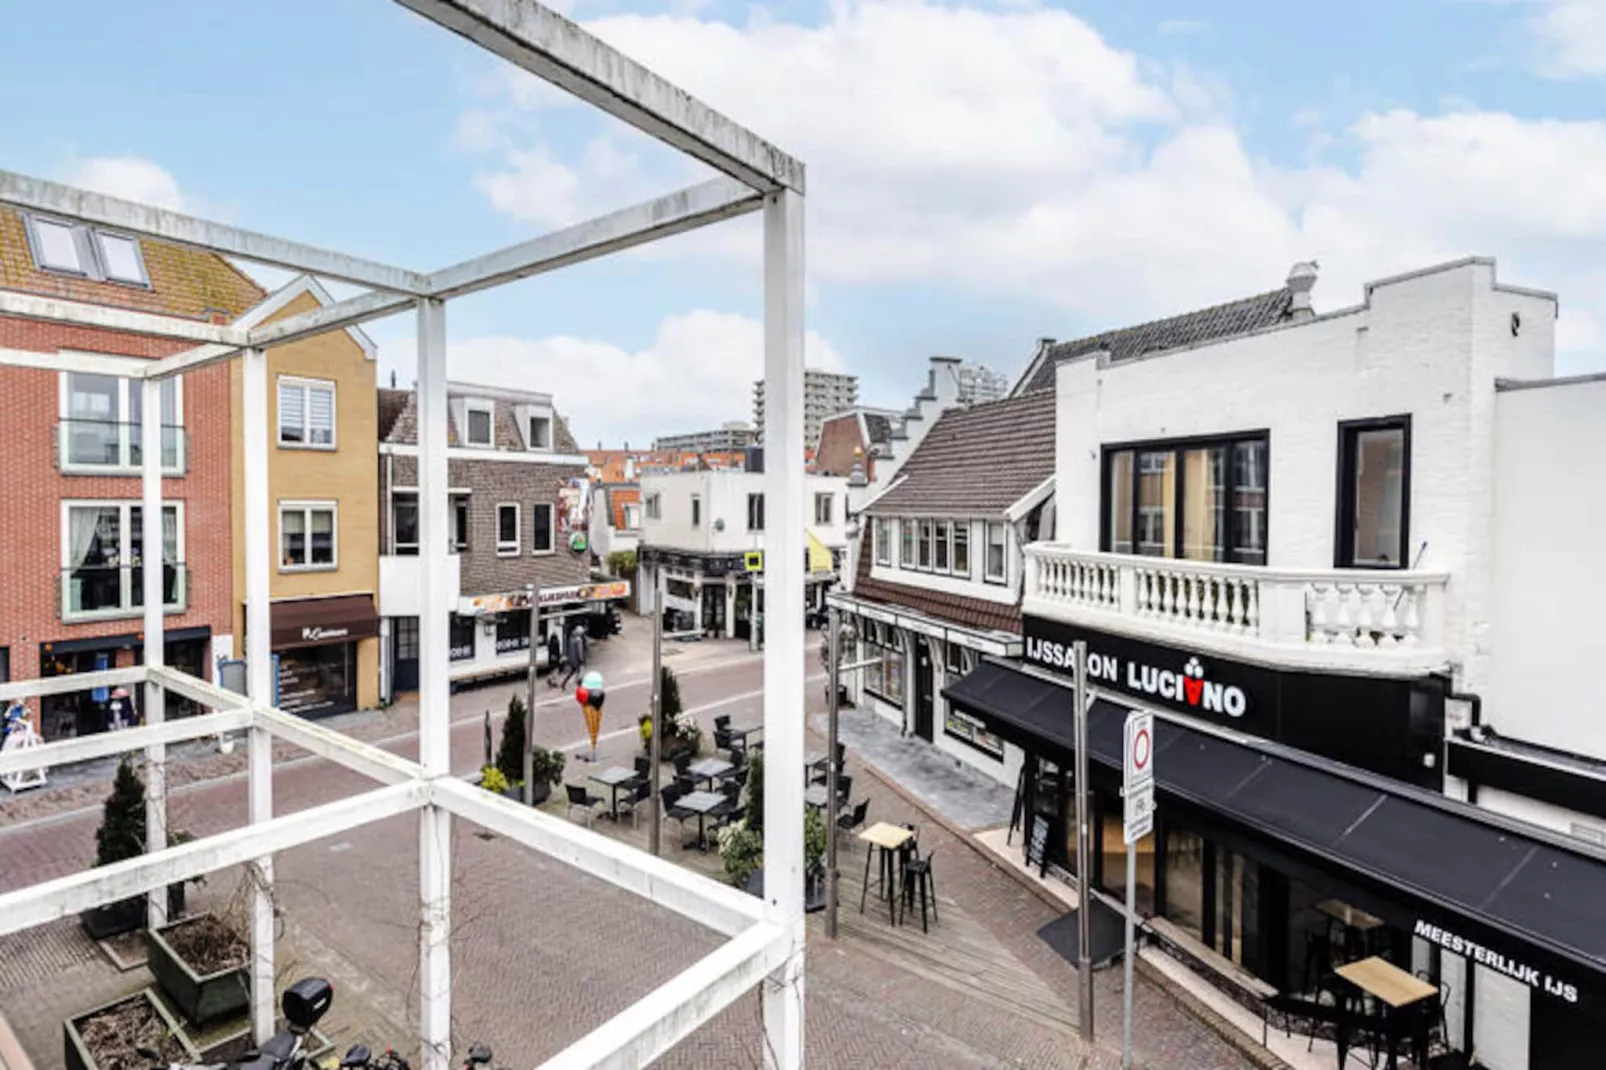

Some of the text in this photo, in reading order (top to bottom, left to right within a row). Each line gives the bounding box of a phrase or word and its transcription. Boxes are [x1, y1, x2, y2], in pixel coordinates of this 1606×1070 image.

[1027, 637, 1118, 681] IJSSAON
[1414, 919, 1578, 1003] MEESTERLIJK IJS
